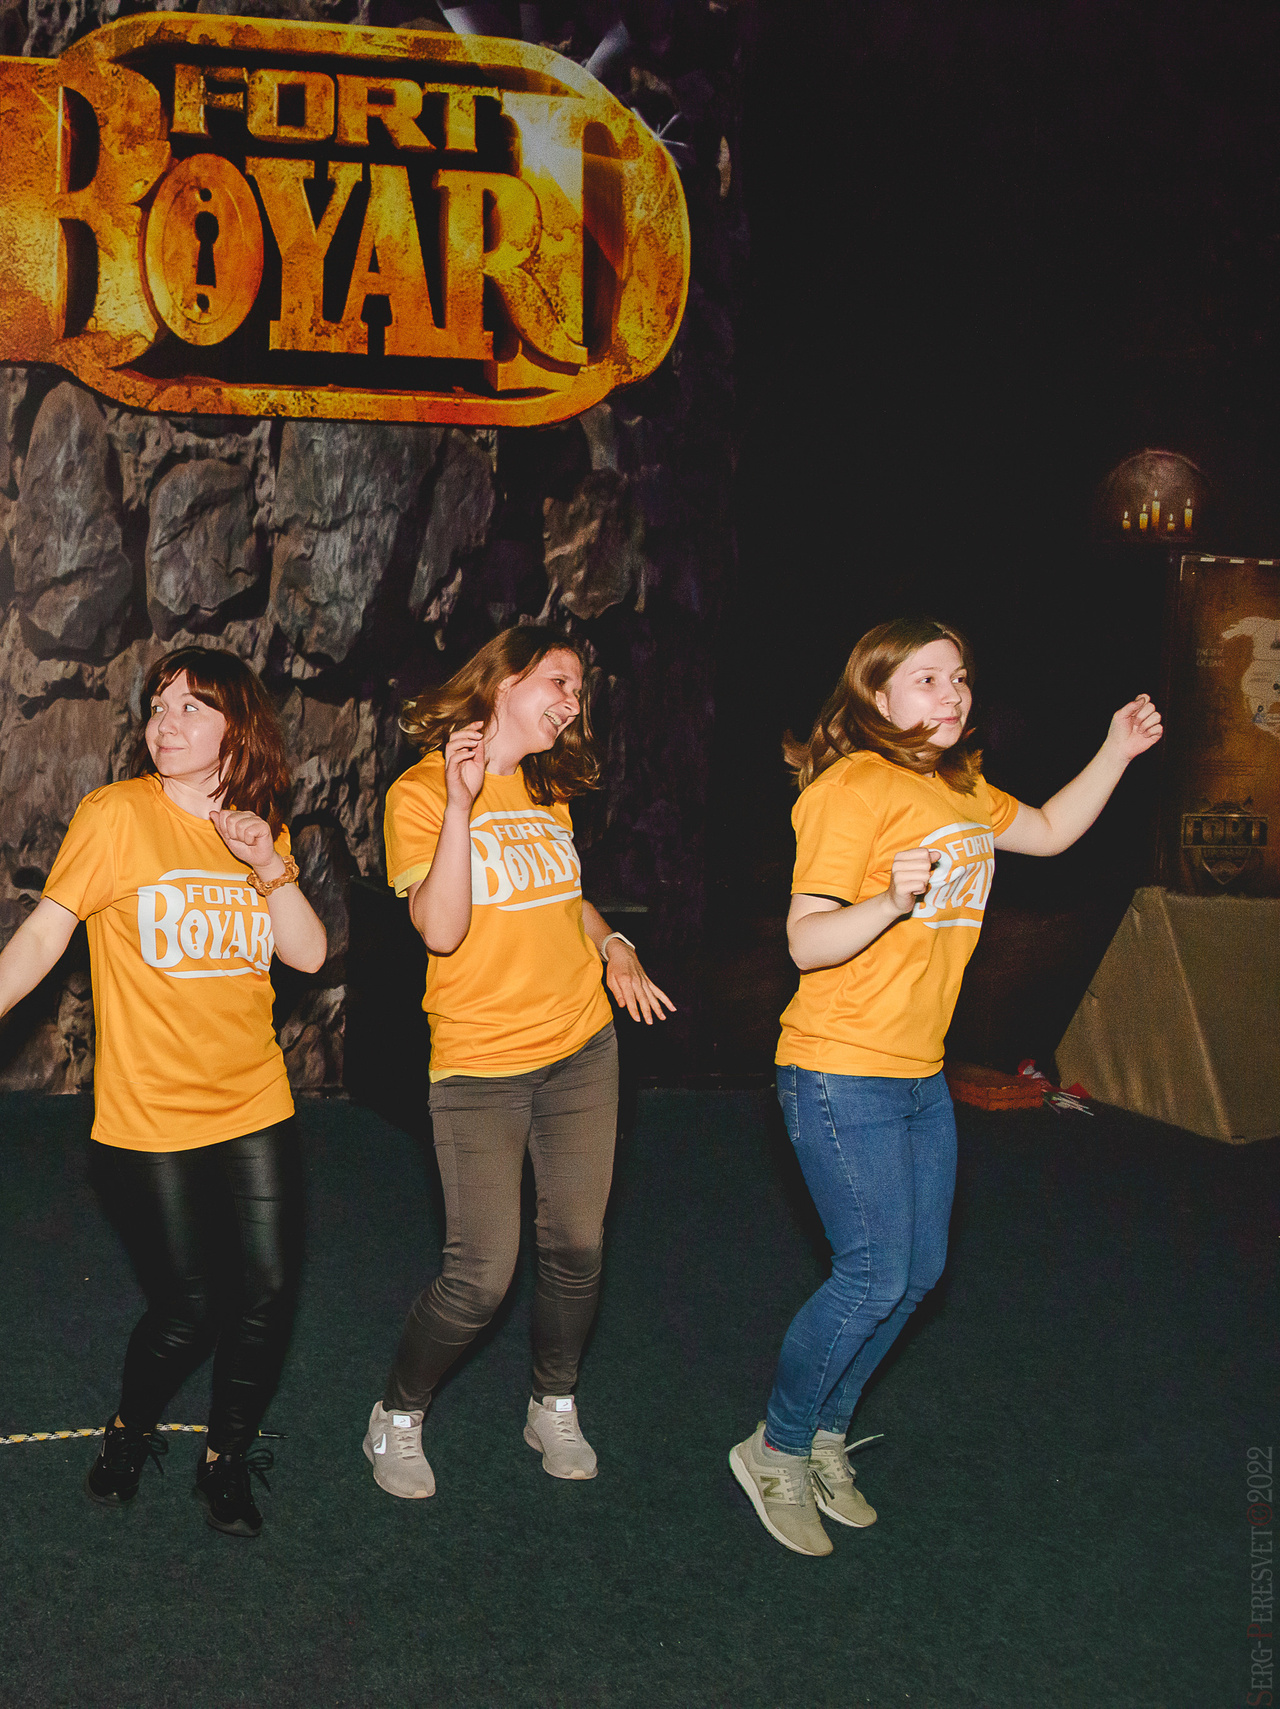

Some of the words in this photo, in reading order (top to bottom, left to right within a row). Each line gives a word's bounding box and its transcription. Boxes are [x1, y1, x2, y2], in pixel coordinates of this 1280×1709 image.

[171, 64, 508, 153] FORT
[1185, 817, 1267, 844] FORT
[945, 834, 989, 860] FORT
[186, 884, 259, 906] FORT
[137, 884, 275, 971] BOYAR
